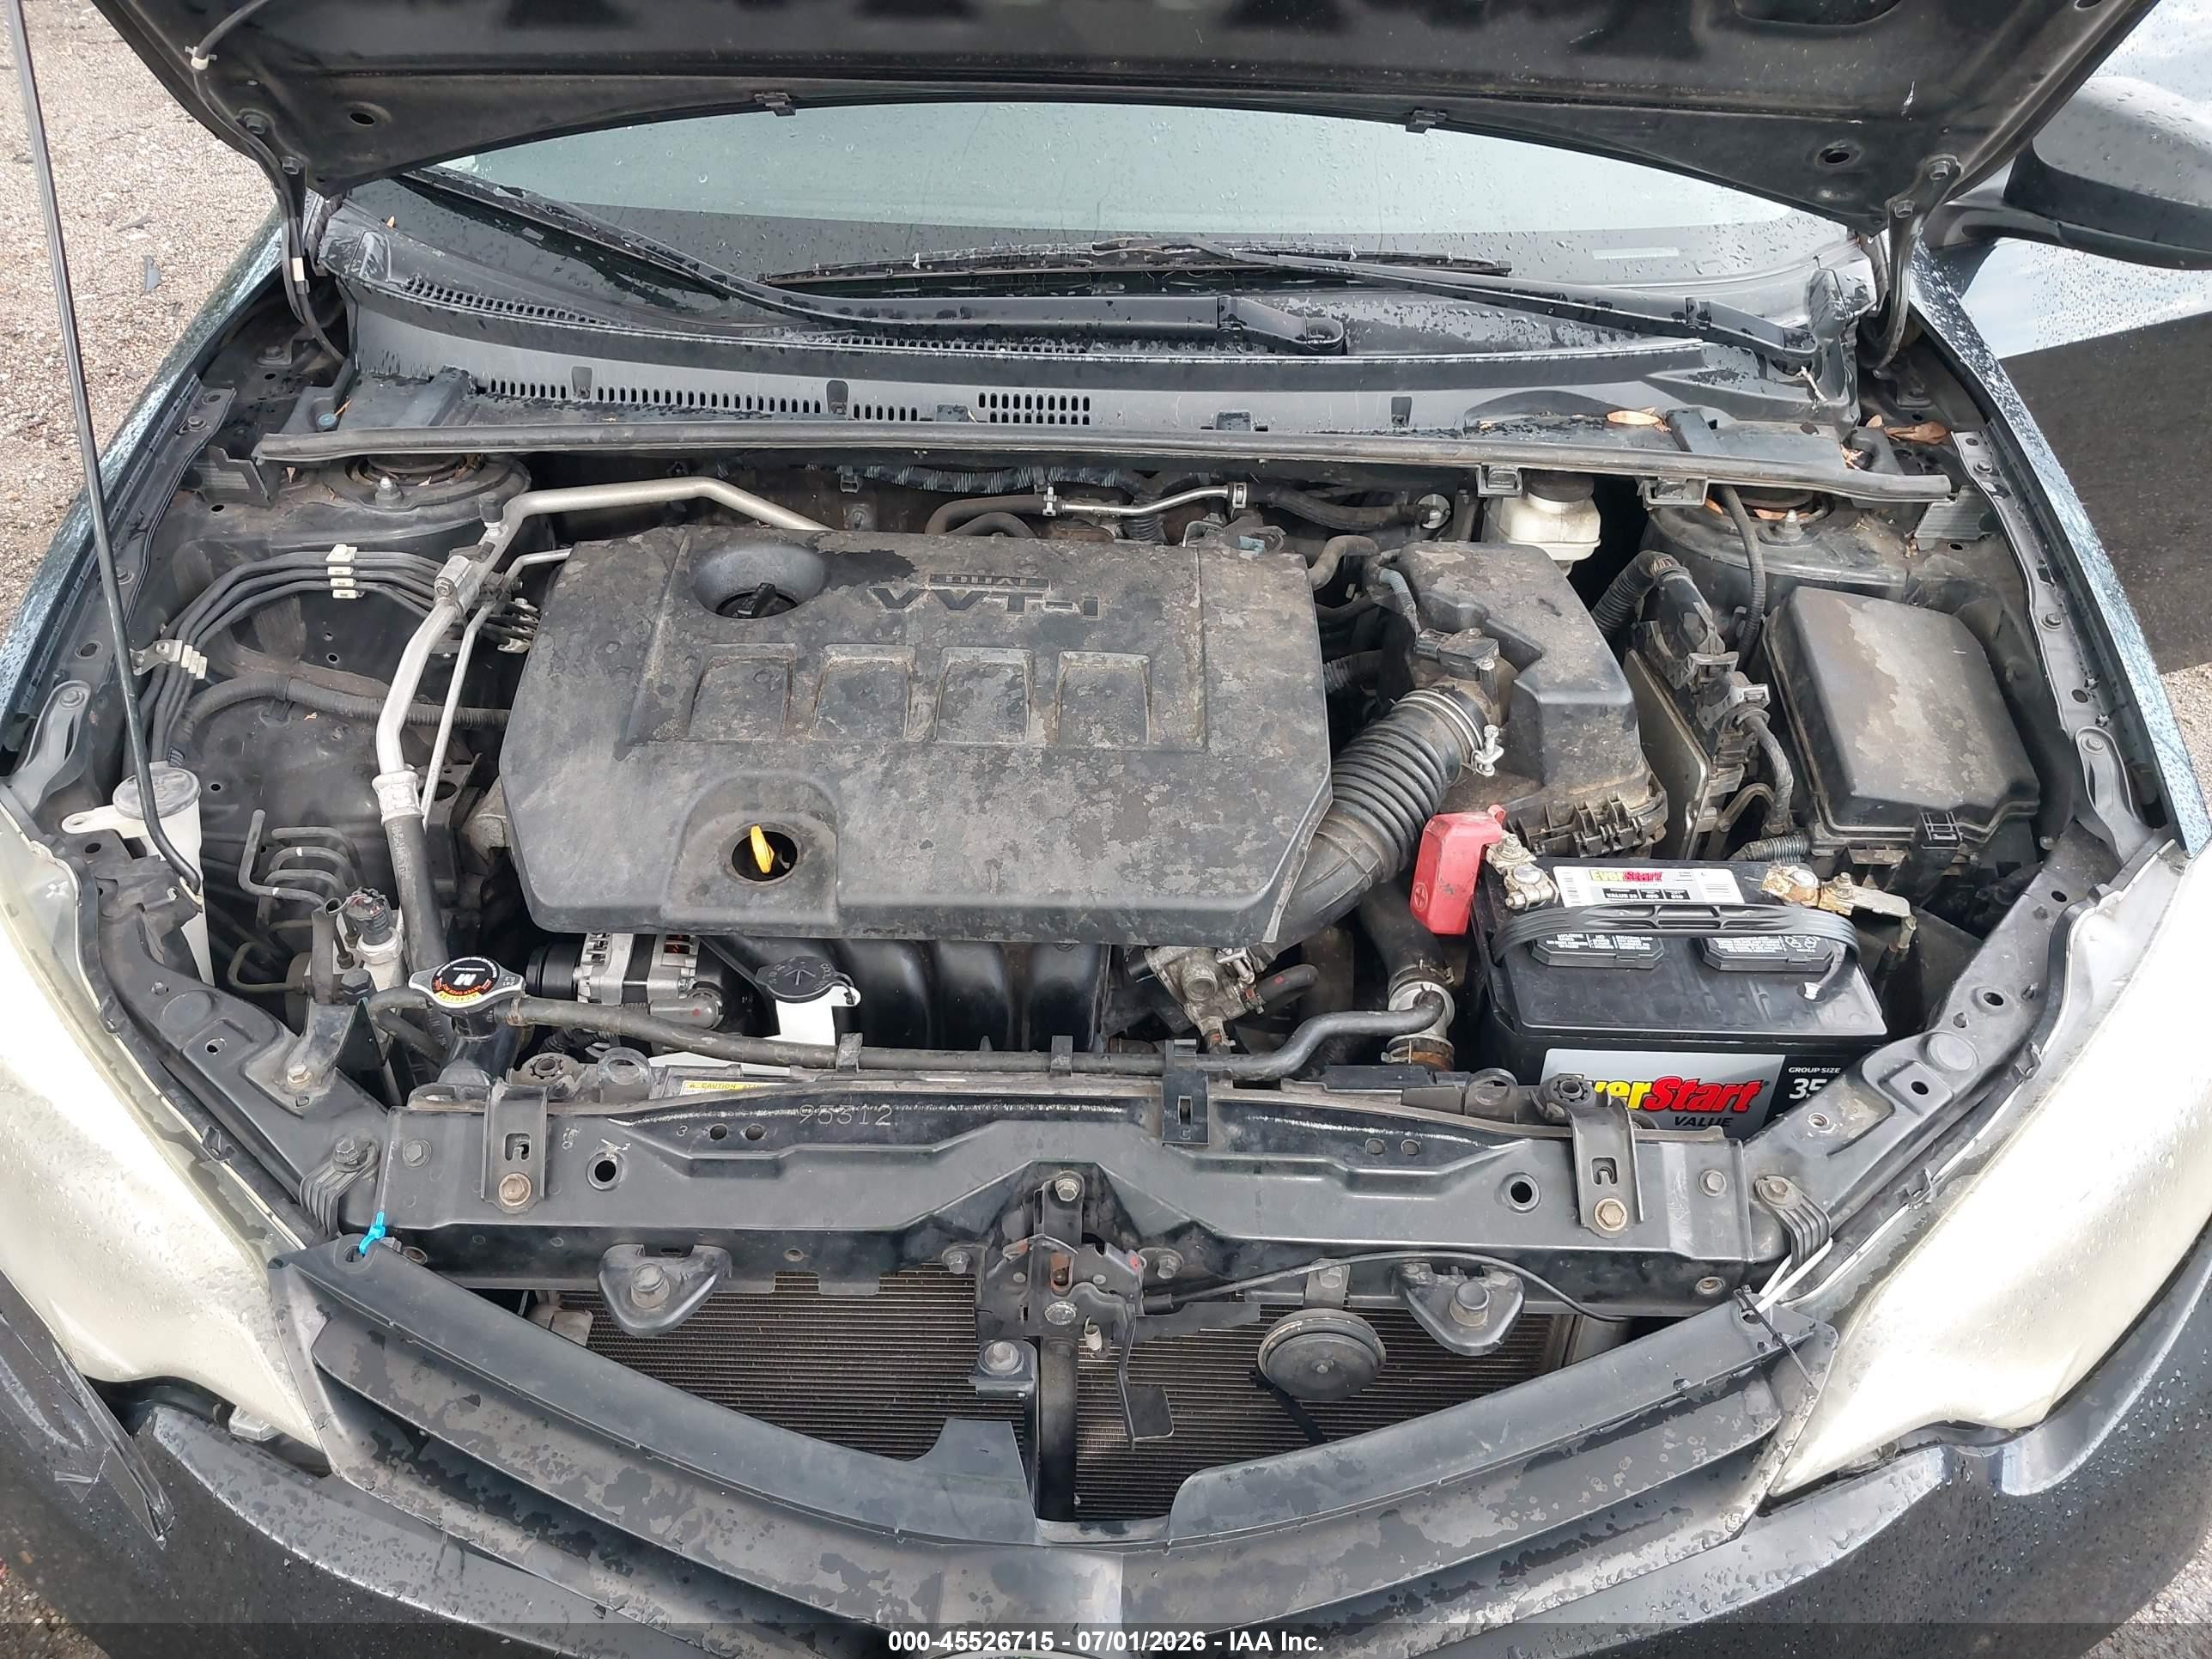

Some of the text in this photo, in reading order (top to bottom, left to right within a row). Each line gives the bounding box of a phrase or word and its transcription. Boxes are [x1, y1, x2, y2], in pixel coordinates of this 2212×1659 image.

[1559, 1073, 1764, 1114] erStart
[1789, 1078, 1827, 1099] 35
[1674, 1116, 1733, 1127] VALUE
